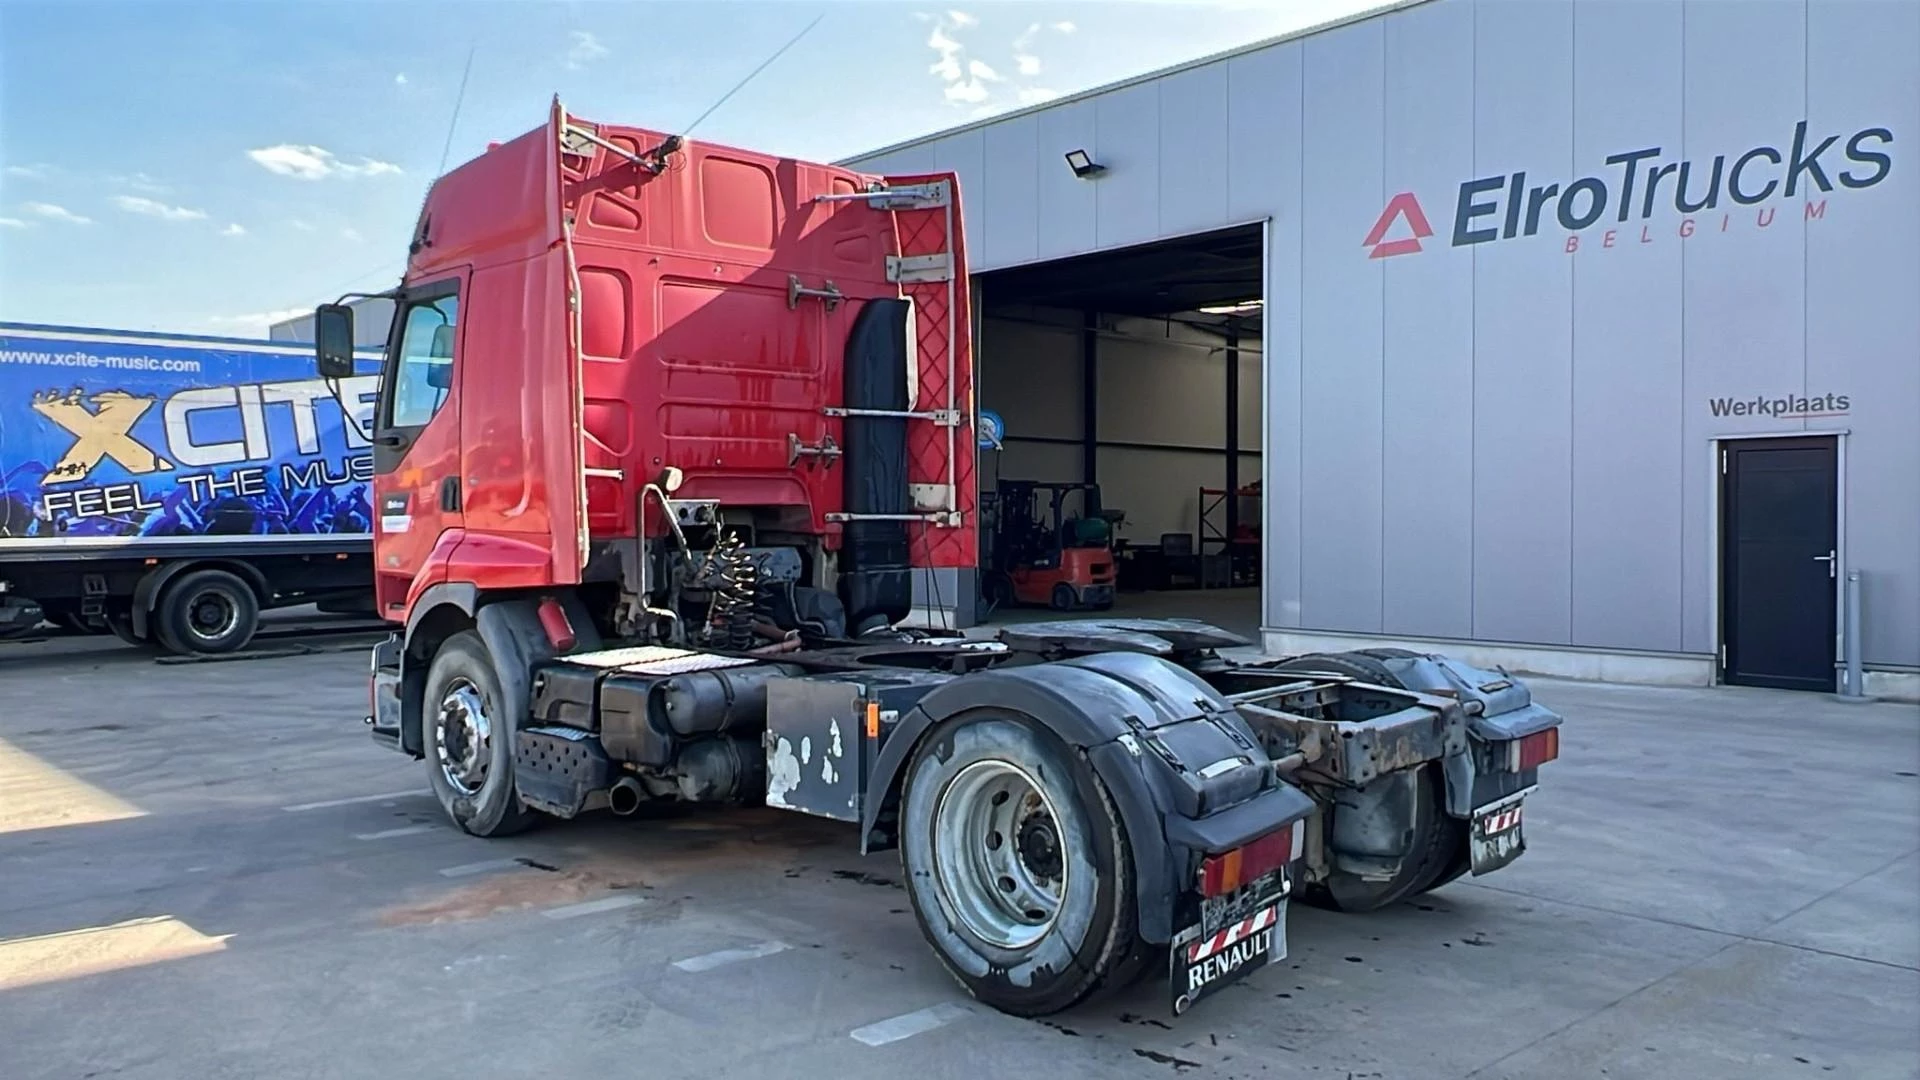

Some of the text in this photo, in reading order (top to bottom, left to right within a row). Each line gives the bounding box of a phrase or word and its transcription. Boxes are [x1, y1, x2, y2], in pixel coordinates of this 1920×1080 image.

[1451, 120, 1894, 247] ElroTrucks
[1565, 200, 1828, 253] BELGIUM
[0, 351, 201, 373] www.xcite-music.com
[1710, 392, 1850, 418] Werkplaats
[42, 484, 162, 523] FEEL
[178, 469, 267, 502] THE
[1188, 928, 1273, 990] RENAULT
